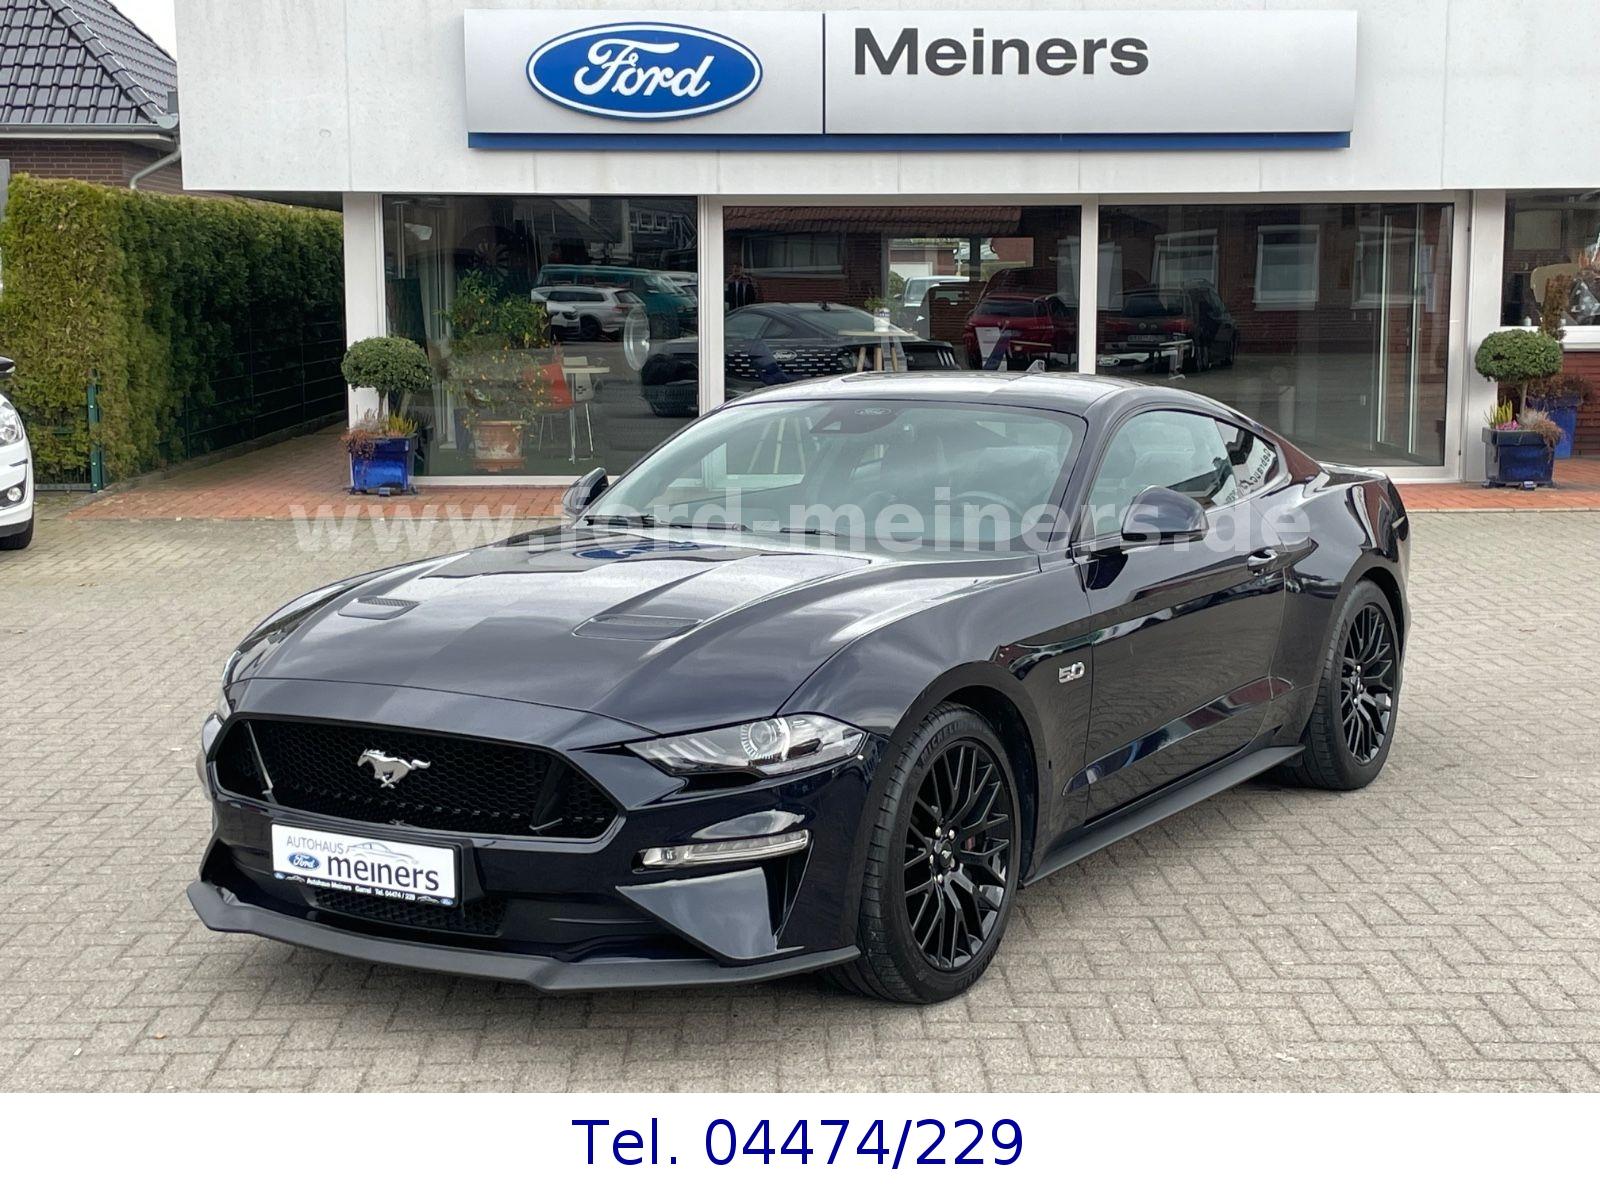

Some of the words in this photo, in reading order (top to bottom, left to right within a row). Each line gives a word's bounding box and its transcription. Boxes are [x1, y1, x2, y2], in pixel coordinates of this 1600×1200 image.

[574, 38, 714, 98] Ford
[854, 27, 1149, 76] Meiners
[286, 835, 344, 855] AUTOHAUS
[328, 855, 440, 892] meiners
